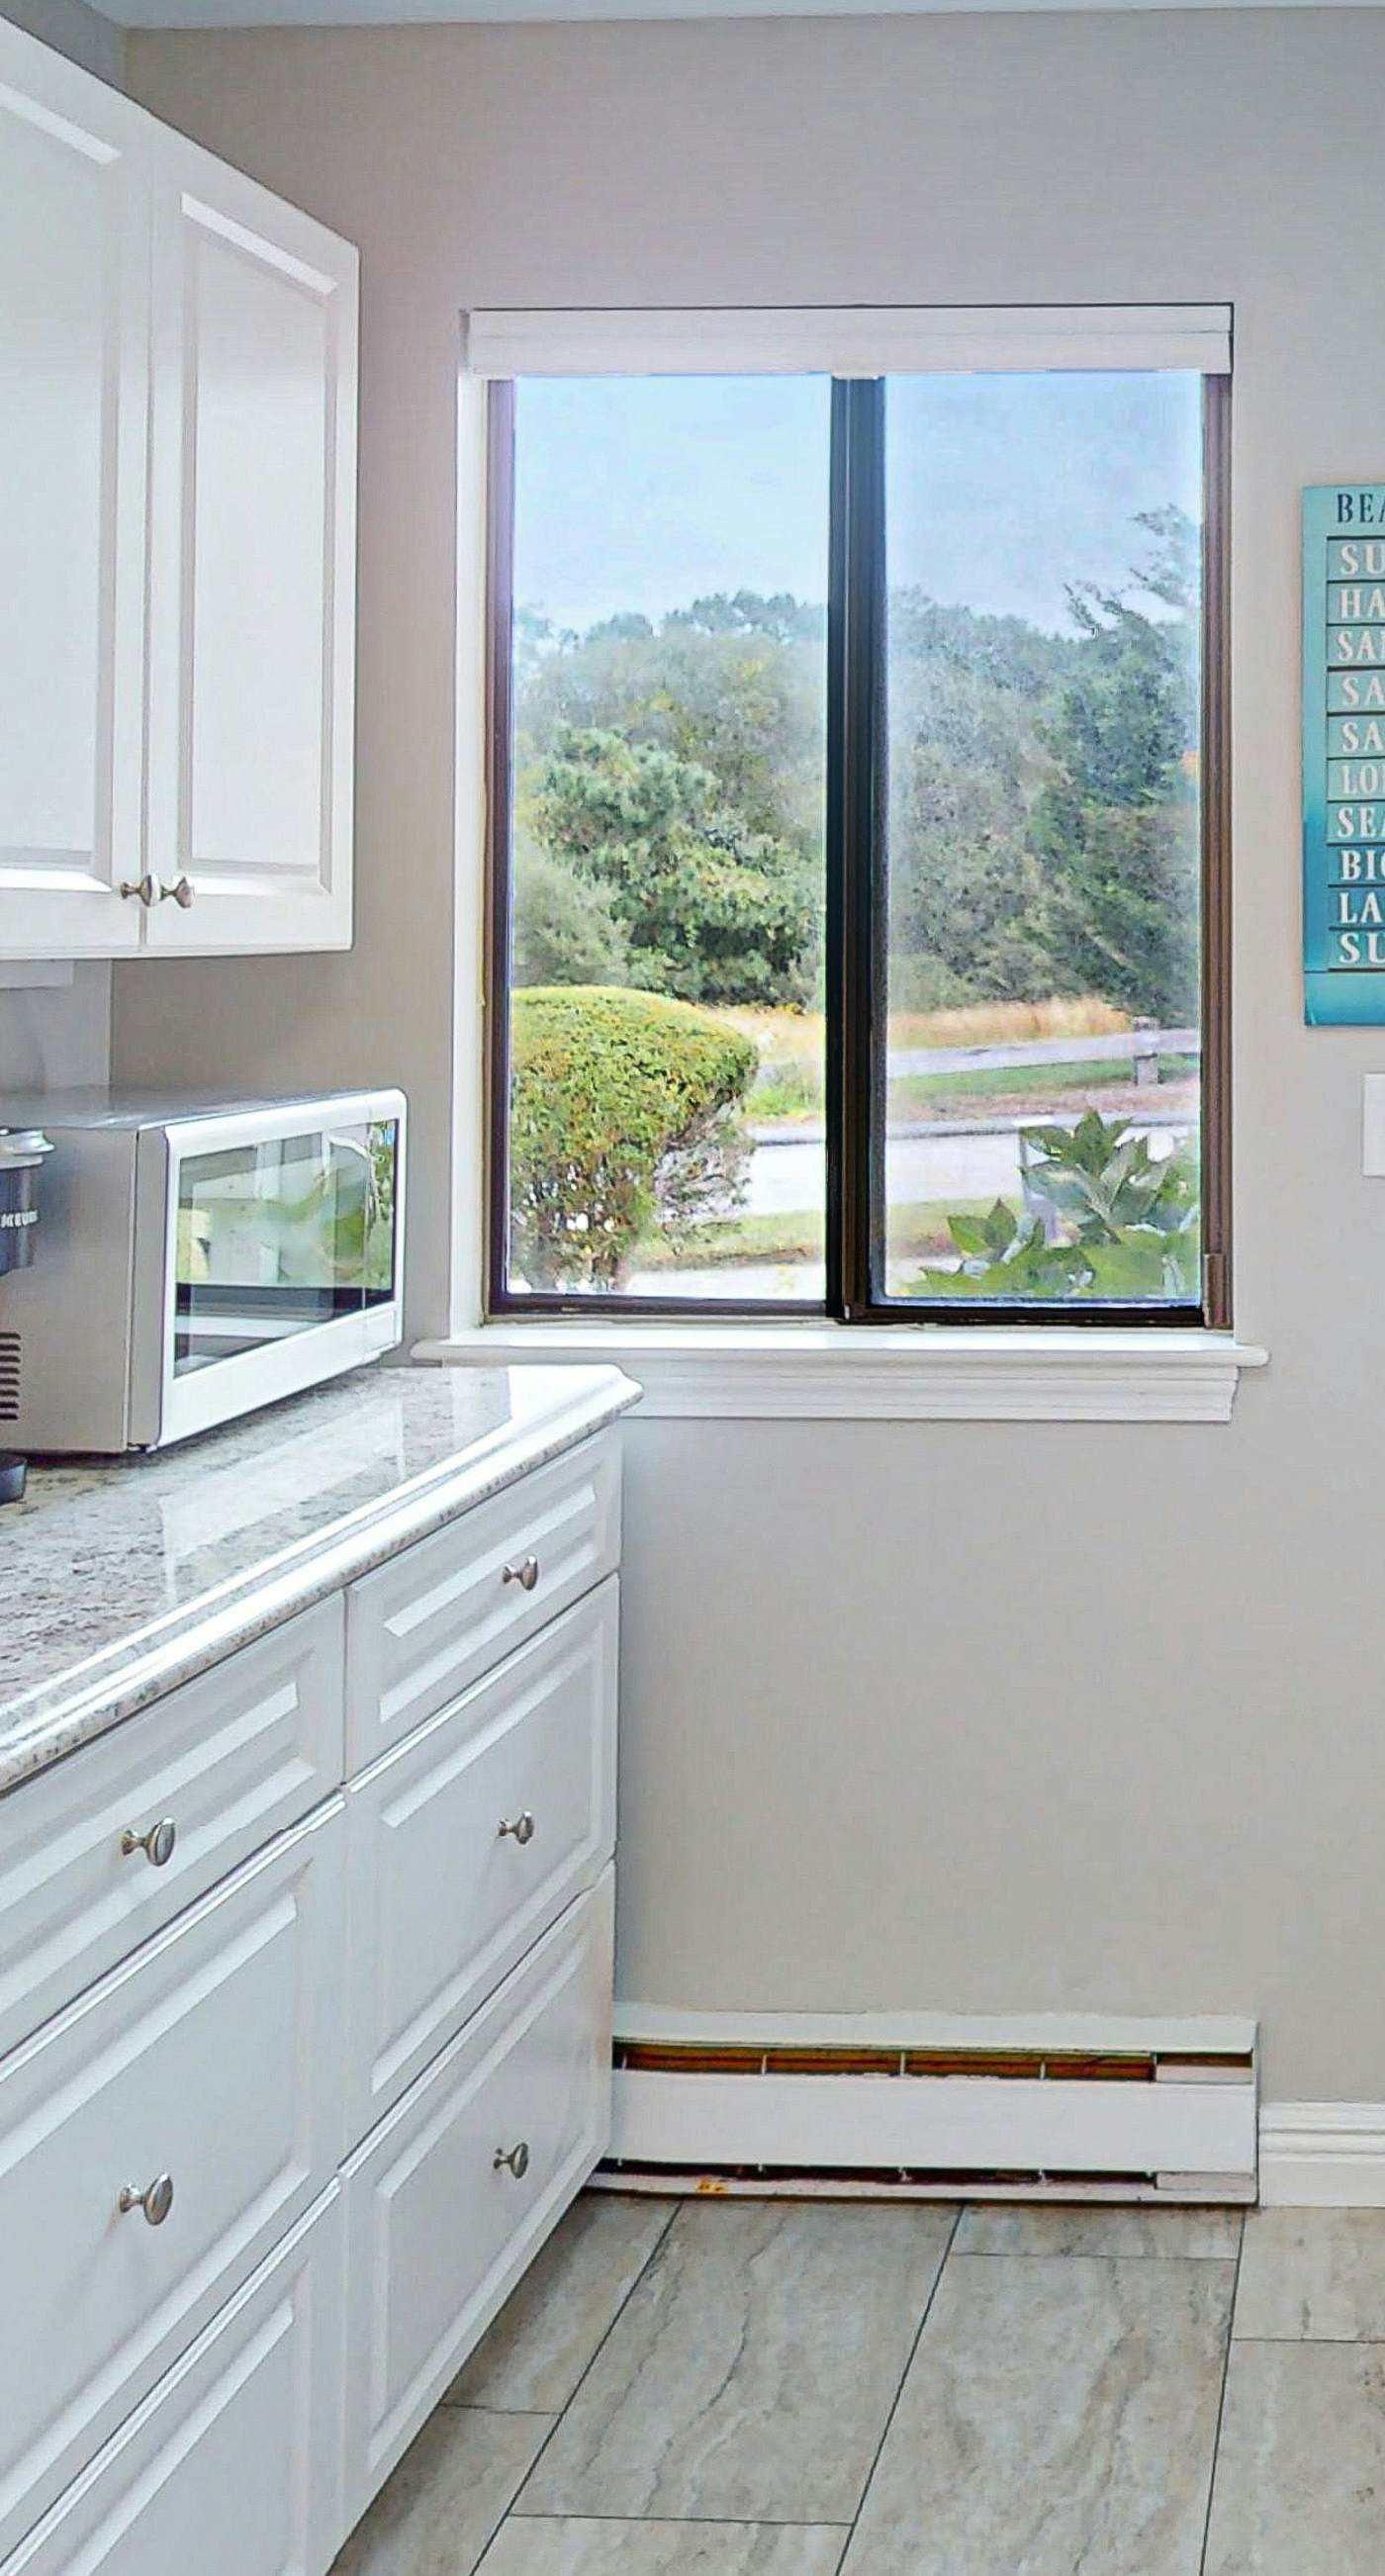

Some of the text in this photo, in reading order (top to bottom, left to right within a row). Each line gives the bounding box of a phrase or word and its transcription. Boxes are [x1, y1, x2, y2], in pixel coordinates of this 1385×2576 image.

[1341, 588, 1385, 618] HA
[1339, 630, 1385, 662] SA
[1342, 677, 1385, 705] SA
[1342, 721, 1384, 752] SA
[1341, 764, 1385, 793] LO
[1338, 806, 1385, 838] SE
[1339, 891, 1383, 923] LA
